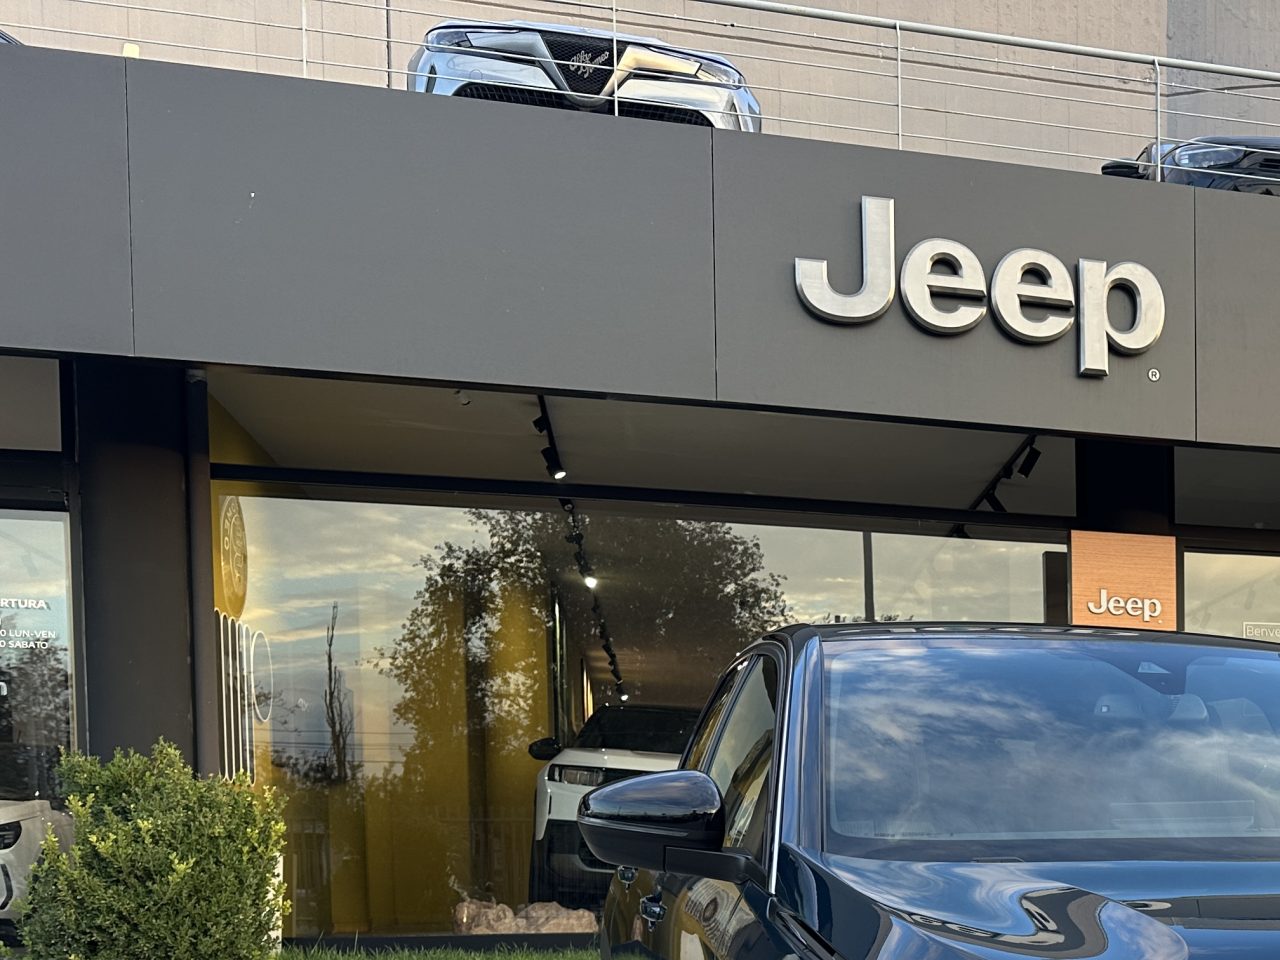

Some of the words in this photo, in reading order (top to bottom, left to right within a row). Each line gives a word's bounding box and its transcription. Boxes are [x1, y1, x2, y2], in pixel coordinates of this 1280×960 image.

[794, 194, 1166, 379] Jeep
[1087, 588, 1162, 622] Jeep
[8, 640, 48, 649] SABATO
[9, 629, 56, 639] LUN-VEN
